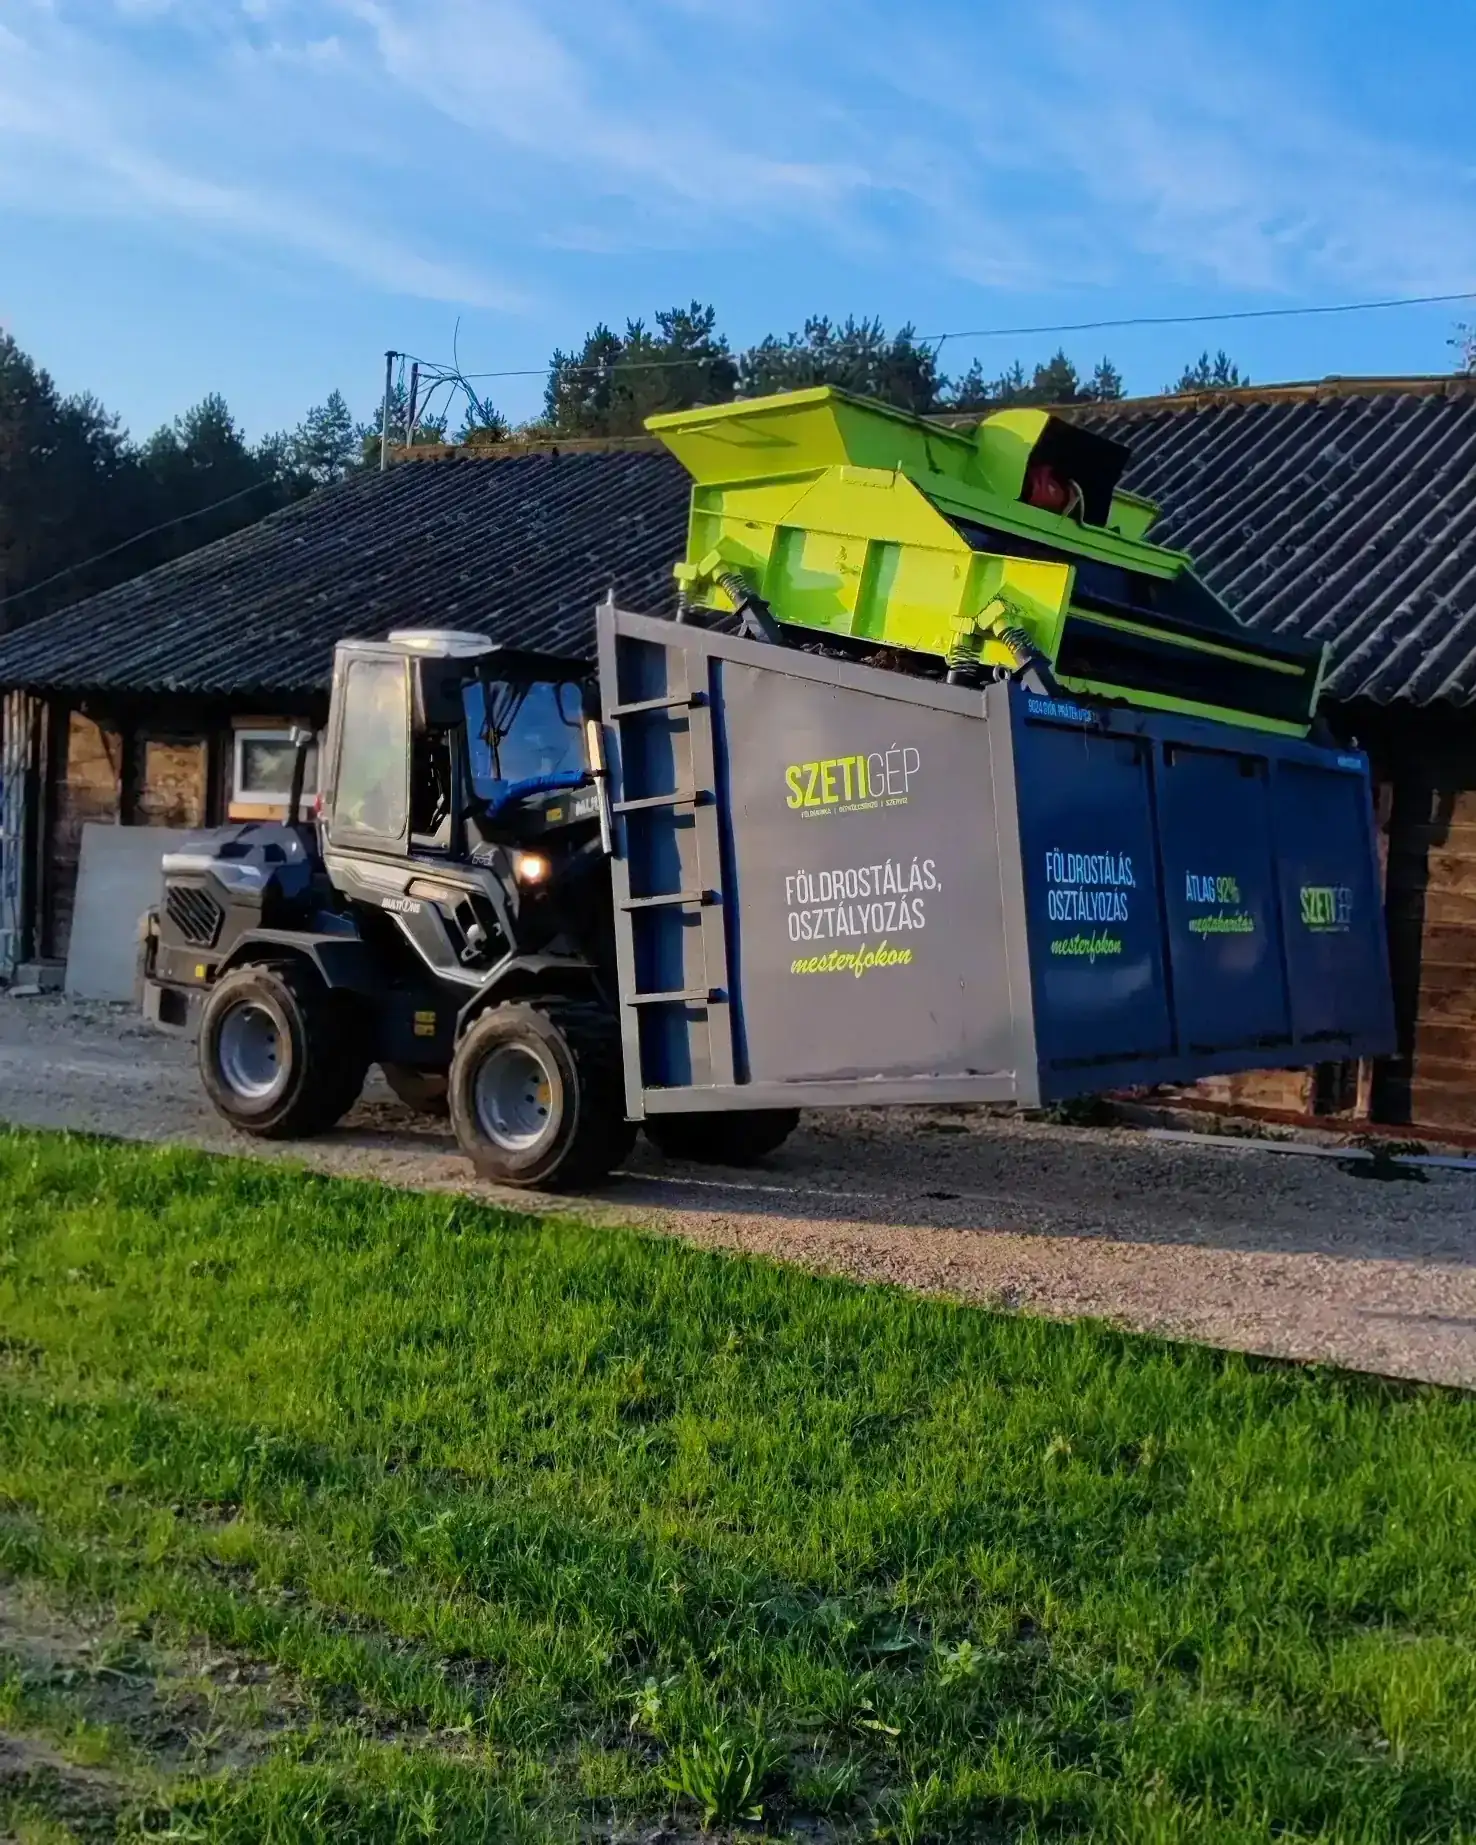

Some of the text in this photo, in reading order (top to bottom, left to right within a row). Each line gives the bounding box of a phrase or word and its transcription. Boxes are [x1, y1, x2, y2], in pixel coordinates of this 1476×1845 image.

[785, 743, 920, 809] SZETIGÉP
[785, 856, 942, 905] FÖLDROSTÁLÁS,
[1045, 847, 1136, 889] FÖLDROSTÁLÁS,
[1186, 870, 1215, 903] ÁTLAG
[788, 894, 926, 942] OSZTÁLYOZÁS
[1048, 886, 1128, 922] OSZTÁLYOZÁS
[790, 940, 912, 978] mesterfokon
[1051, 928, 1121, 964] mesterfokon
